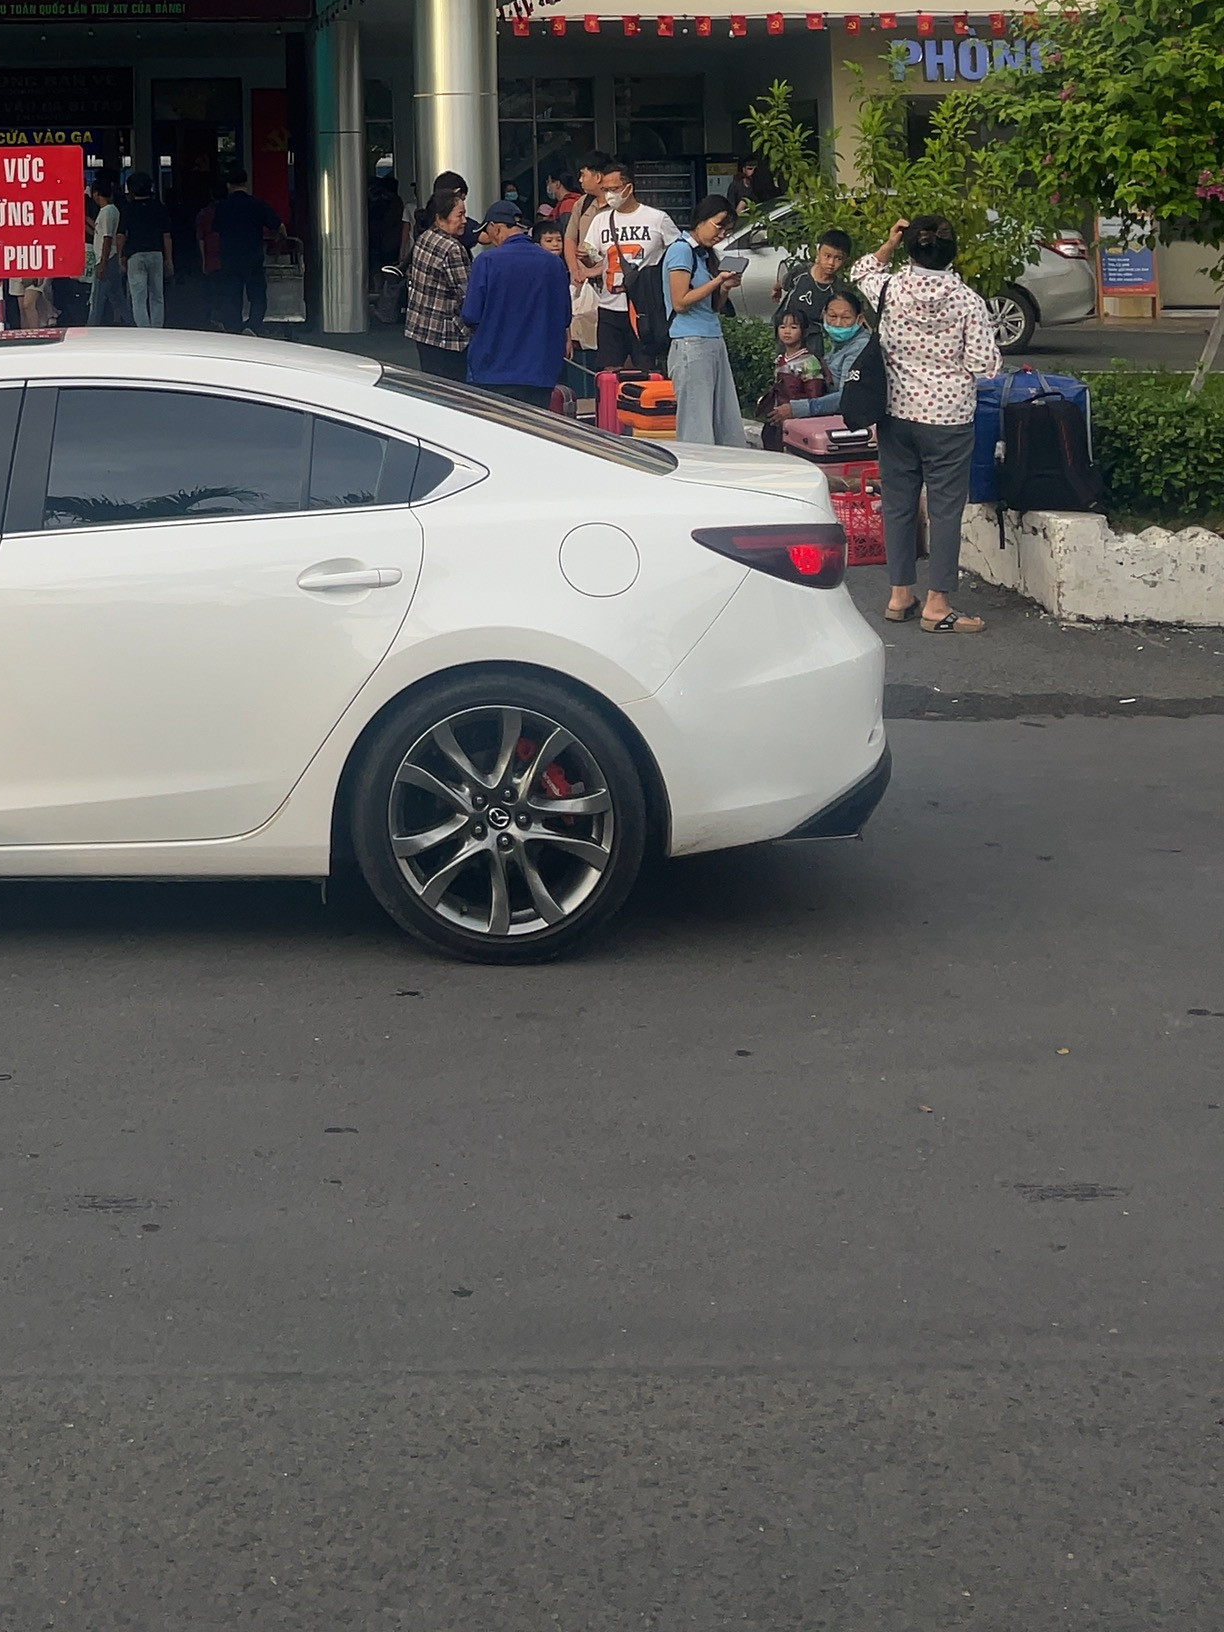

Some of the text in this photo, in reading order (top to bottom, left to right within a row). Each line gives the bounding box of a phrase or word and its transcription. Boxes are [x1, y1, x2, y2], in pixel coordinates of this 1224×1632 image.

[33, 129, 66, 144] VÀO
[71, 131, 94, 143] GA
[3, 154, 45, 188] VỰC
[41, 200, 70, 225] XE
[3, 240, 57, 270] PHÚT
